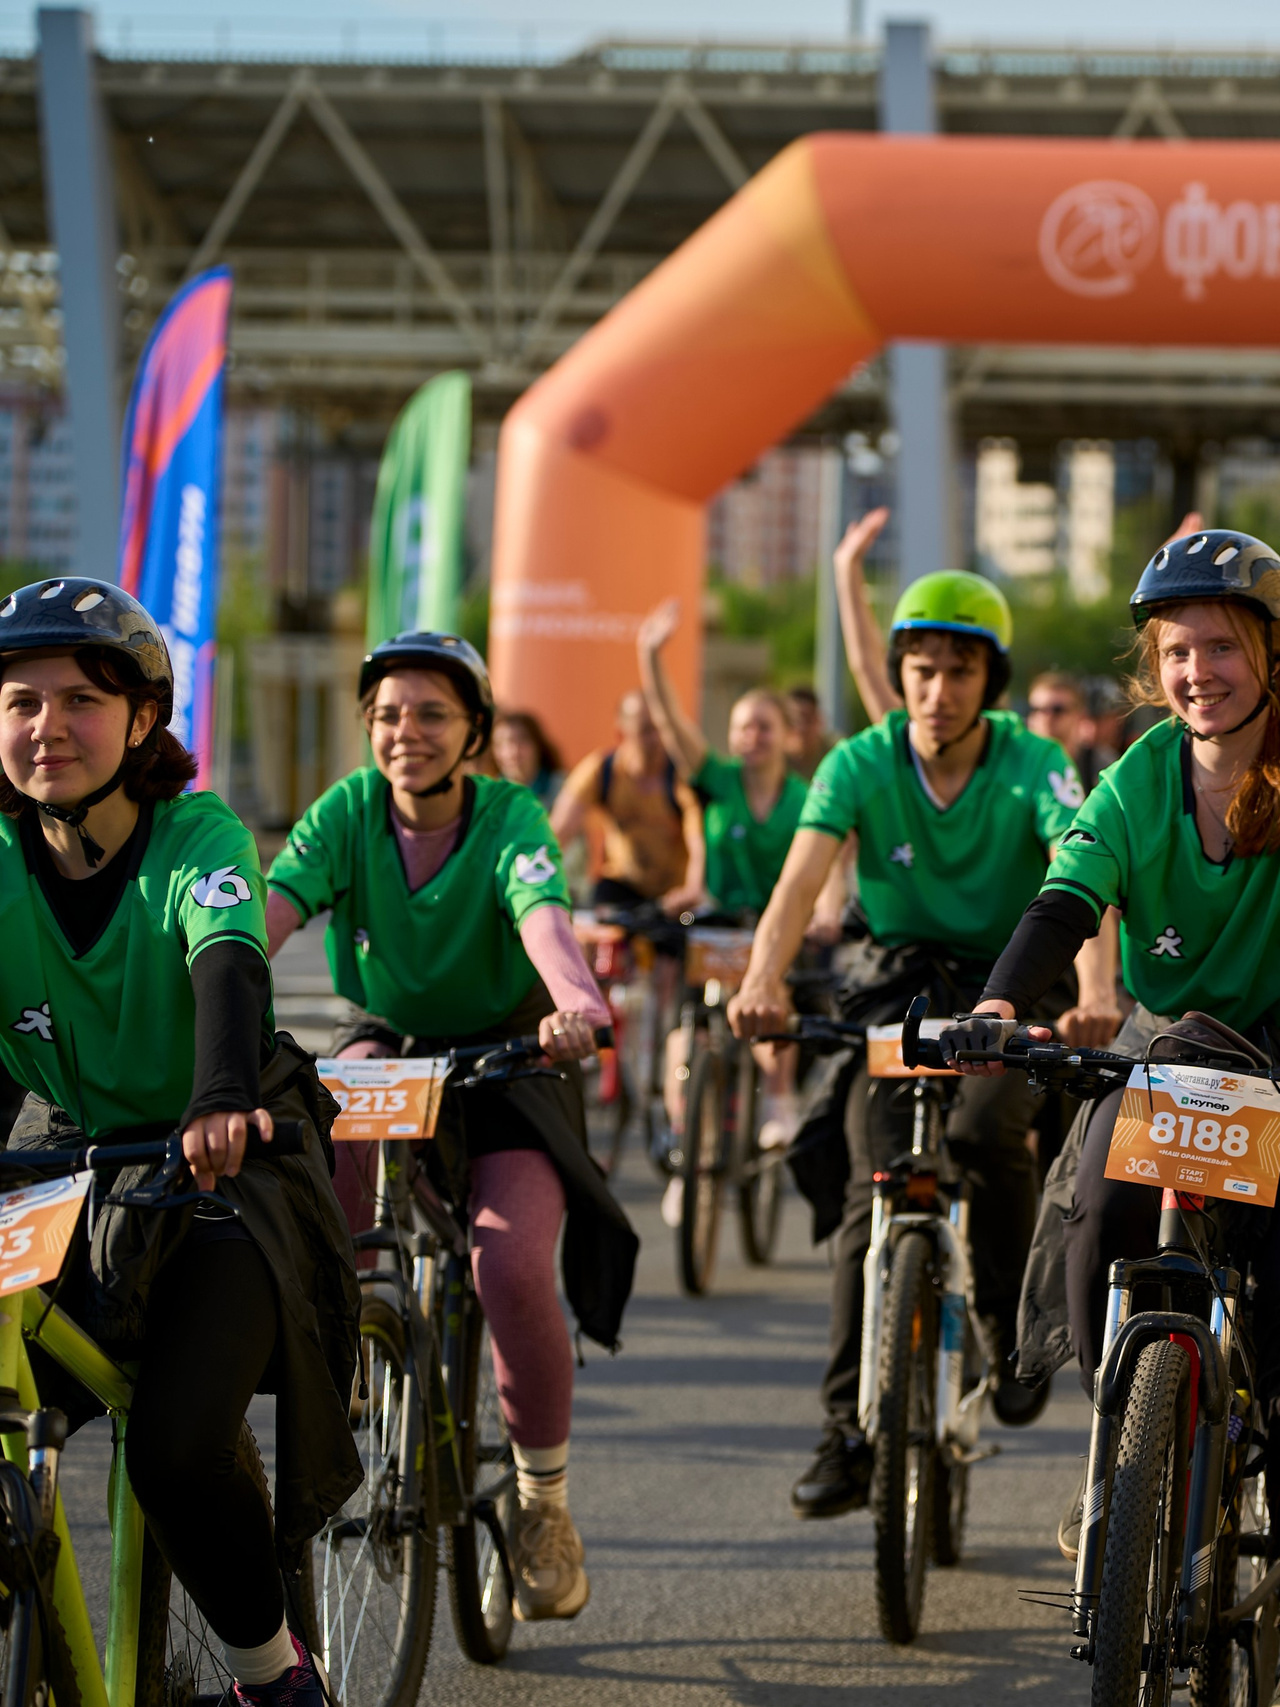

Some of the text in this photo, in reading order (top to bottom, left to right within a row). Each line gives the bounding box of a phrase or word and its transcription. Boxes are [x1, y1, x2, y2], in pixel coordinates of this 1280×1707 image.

[1175, 1072, 1220, 1090] фонтанка.ру
[1190, 1098, 1230, 1111] купер
[1149, 1111, 1249, 1158] 8188
[1180, 1168, 1204, 1177] СТАРТ
